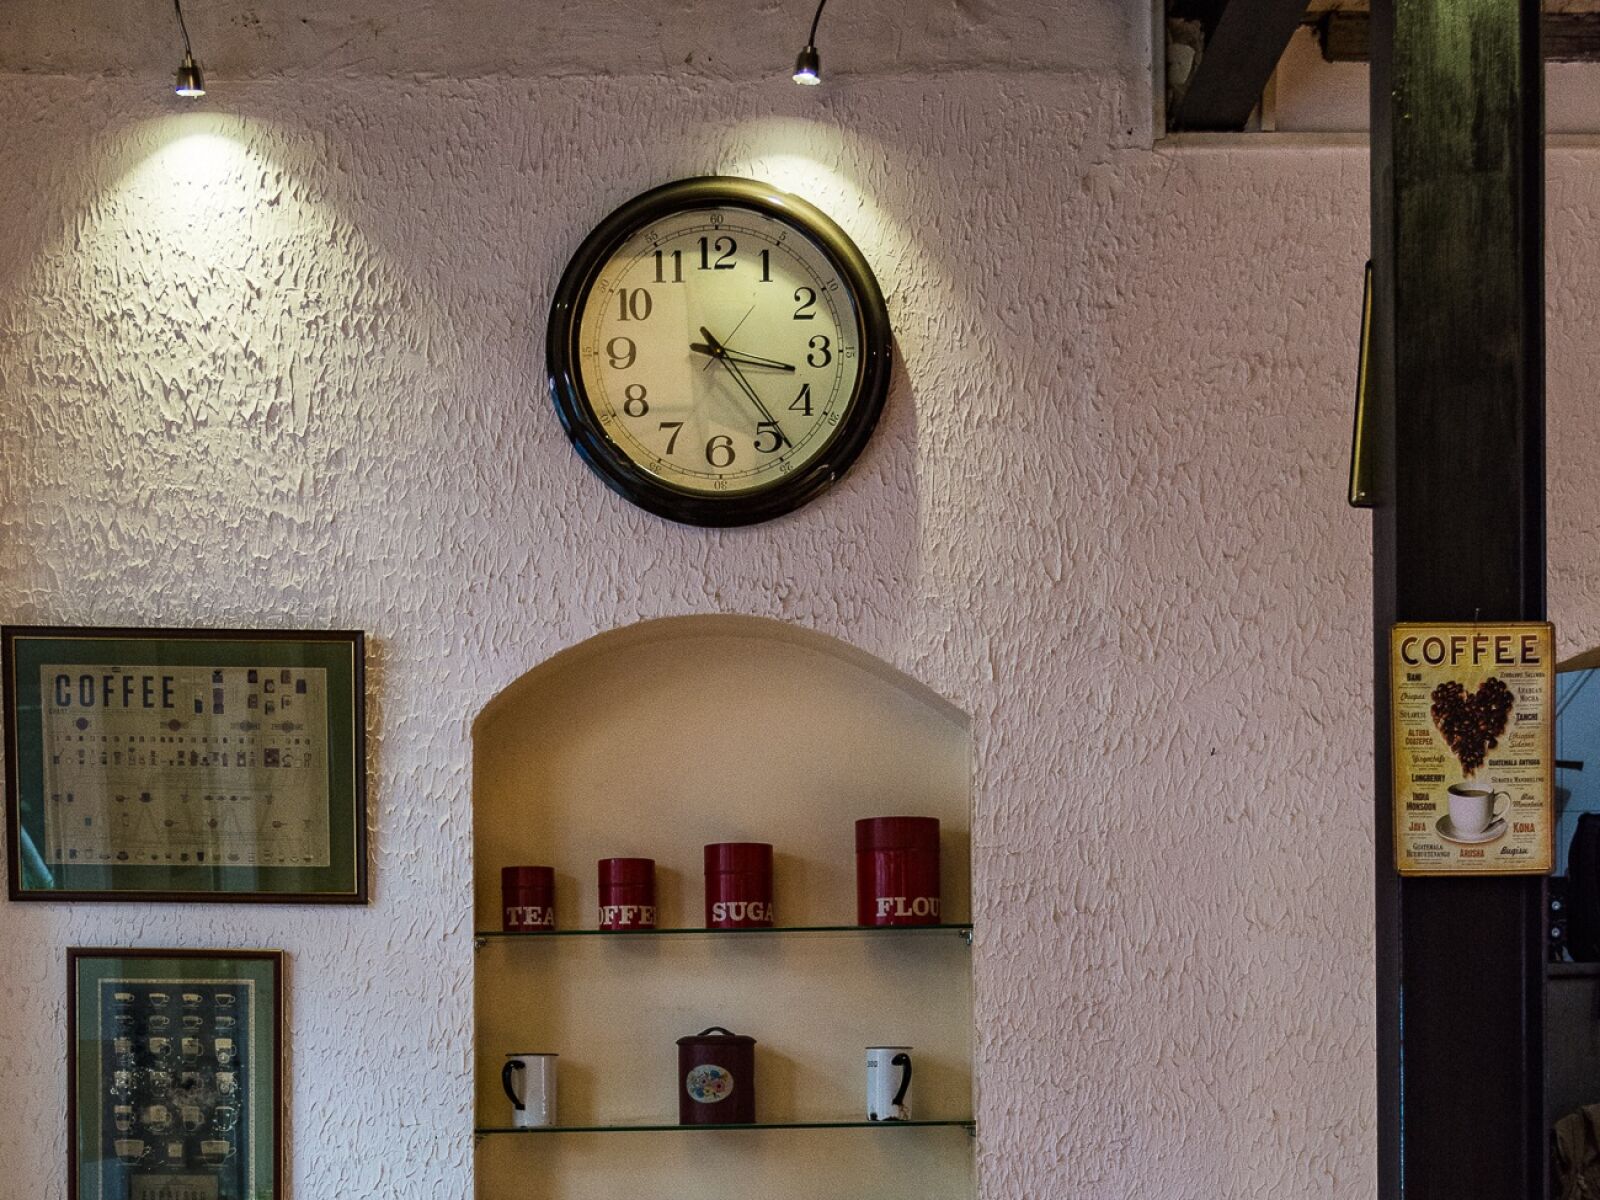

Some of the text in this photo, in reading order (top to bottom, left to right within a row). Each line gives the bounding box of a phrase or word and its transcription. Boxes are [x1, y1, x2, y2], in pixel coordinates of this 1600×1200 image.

[709, 214, 724, 225] 60
[651, 250, 686, 283] 11
[697, 236, 737, 271] 12
[758, 249, 774, 283] 1
[616, 287, 653, 321] 10
[793, 286, 817, 321] 2
[606, 336, 637, 370] 9
[806, 335, 832, 368] 3
[623, 384, 650, 417] 8
[788, 383, 815, 417] 4
[658, 421, 684, 455] 7
[705, 435, 736, 469] 6
[753, 420, 783, 453] 5
[1401, 634, 1541, 665] COFFEE
[55, 674, 175, 709] COFFEE
[1513, 822, 1536, 833] KONA
[506, 906, 555, 926] TEA
